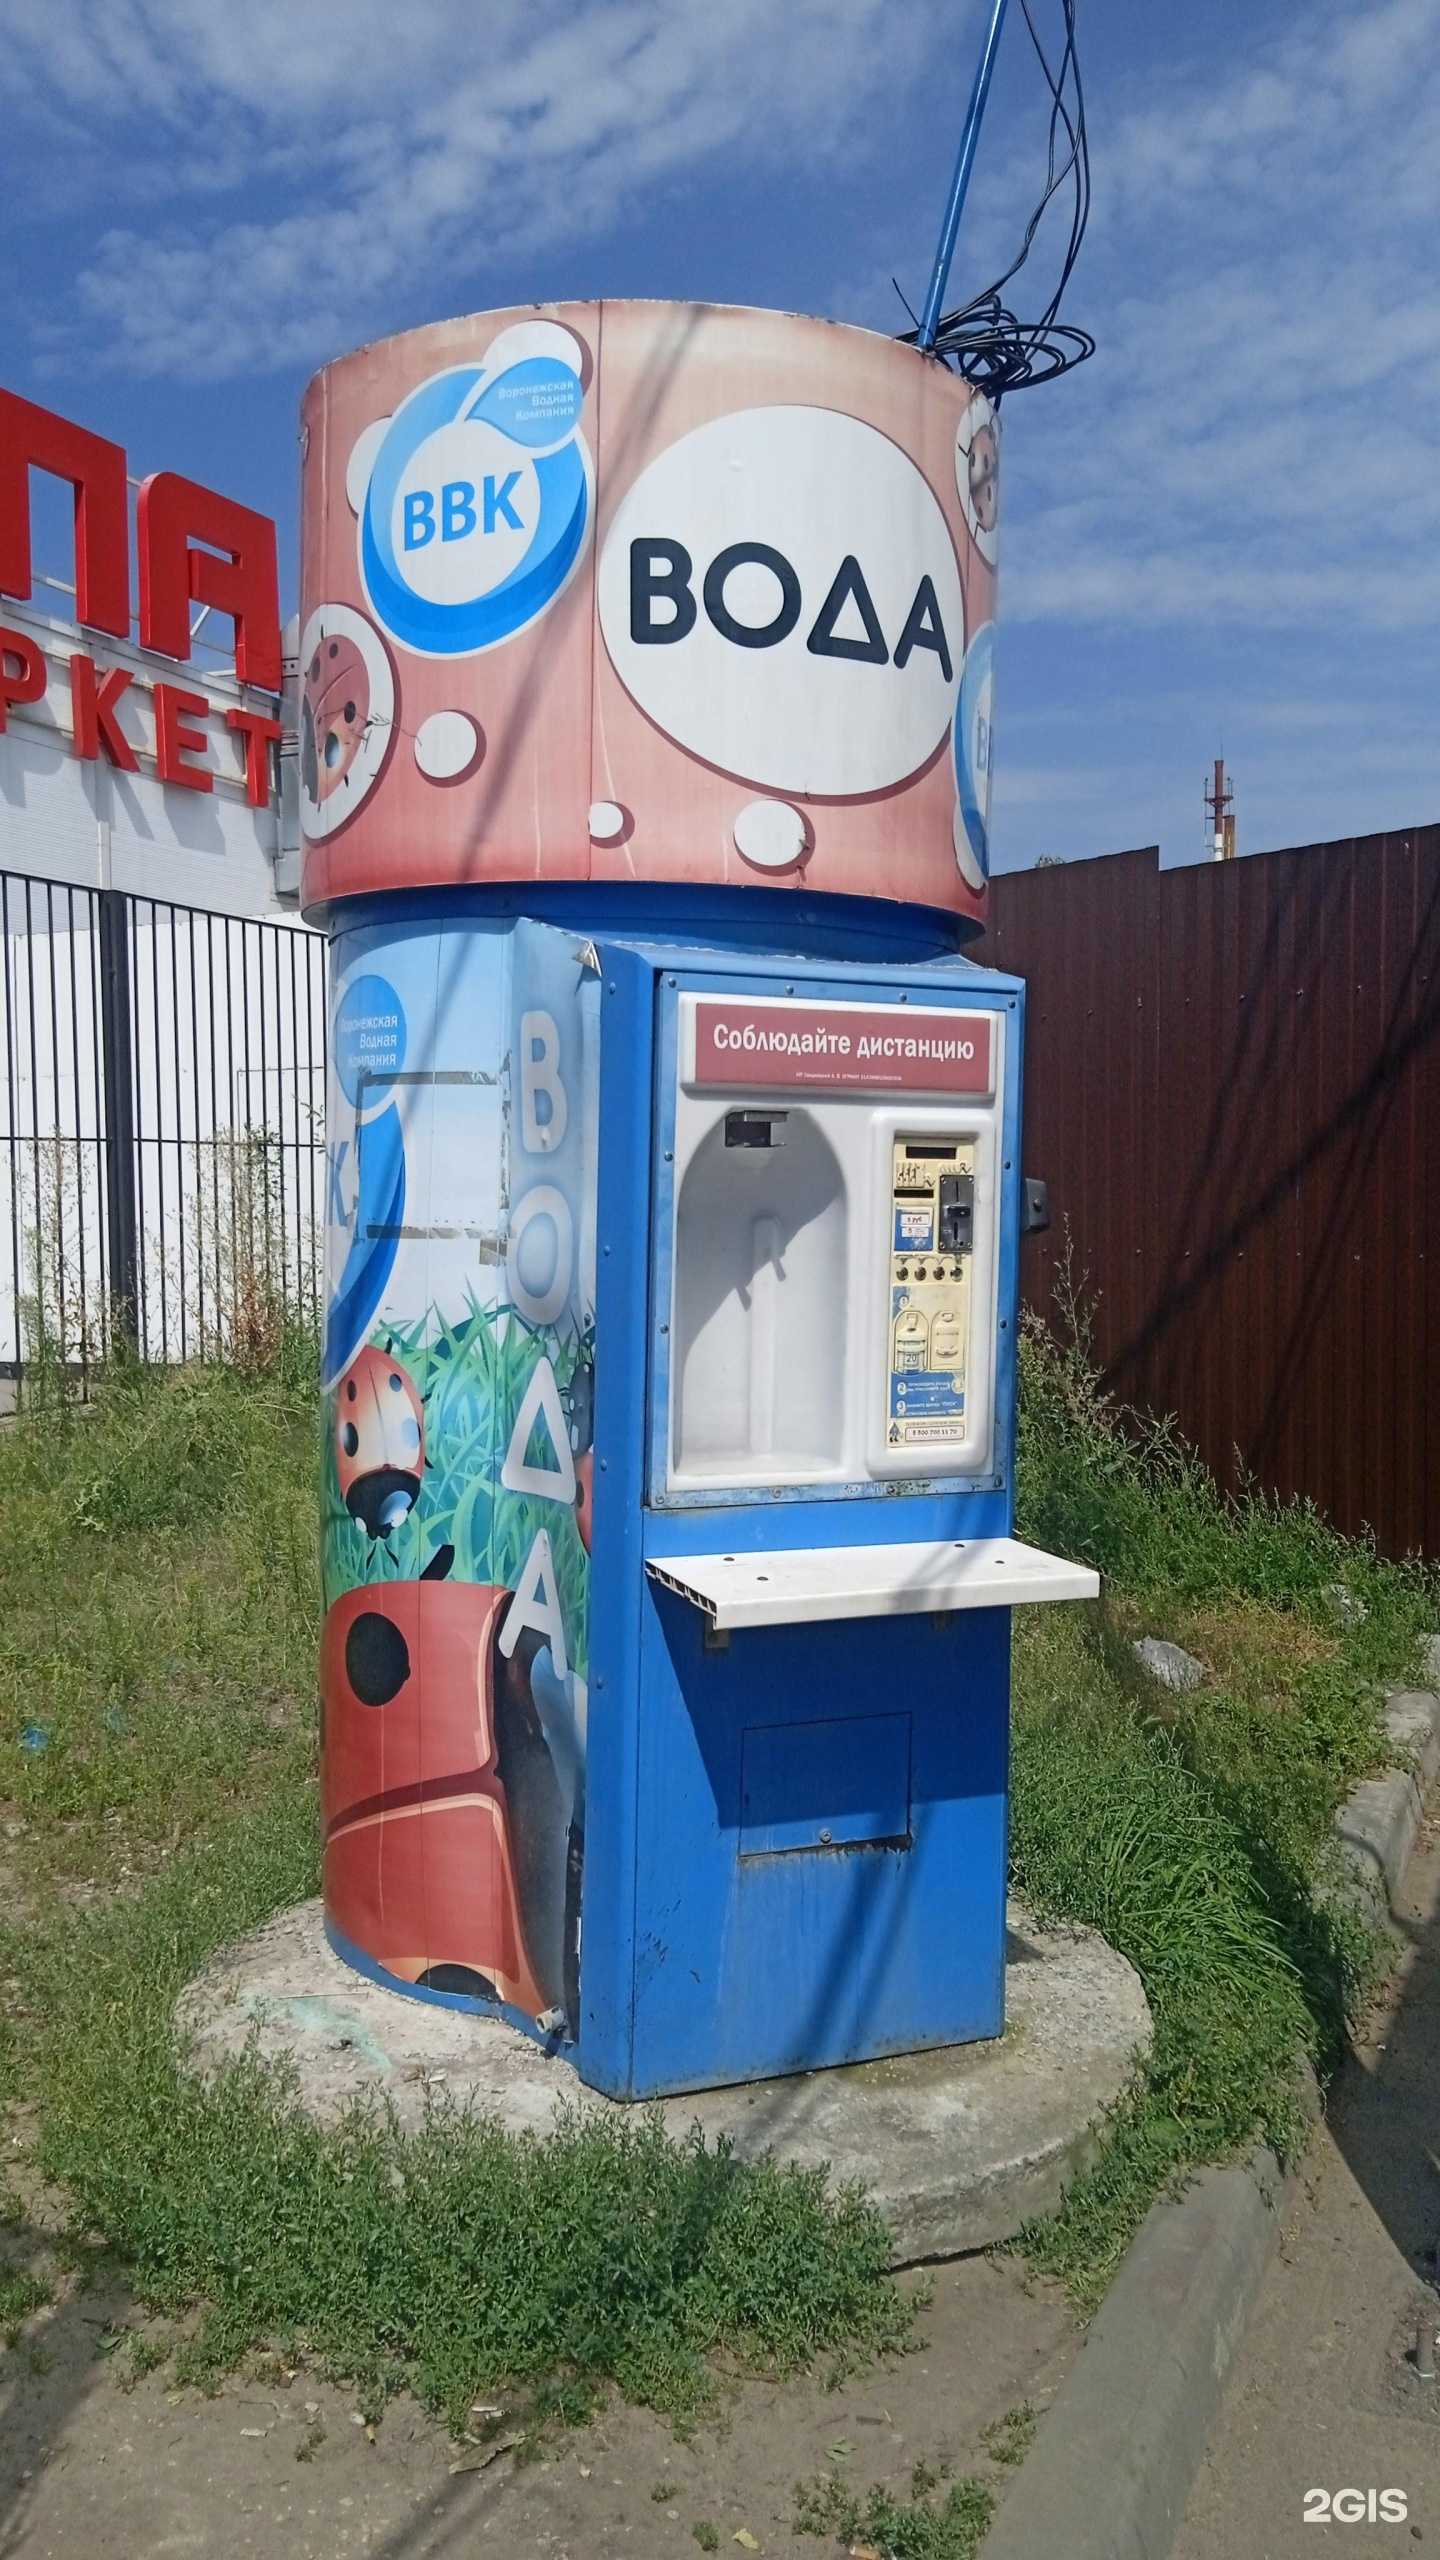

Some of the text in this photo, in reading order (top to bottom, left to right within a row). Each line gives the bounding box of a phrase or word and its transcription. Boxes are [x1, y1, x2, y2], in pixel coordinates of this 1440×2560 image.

[532, 394, 574, 406] Водная
[404, 471, 525, 552] ВВК
[630, 537, 953, 683] ВОДА
[713, 1023, 974, 1061] Соблюдайте дистанцию
